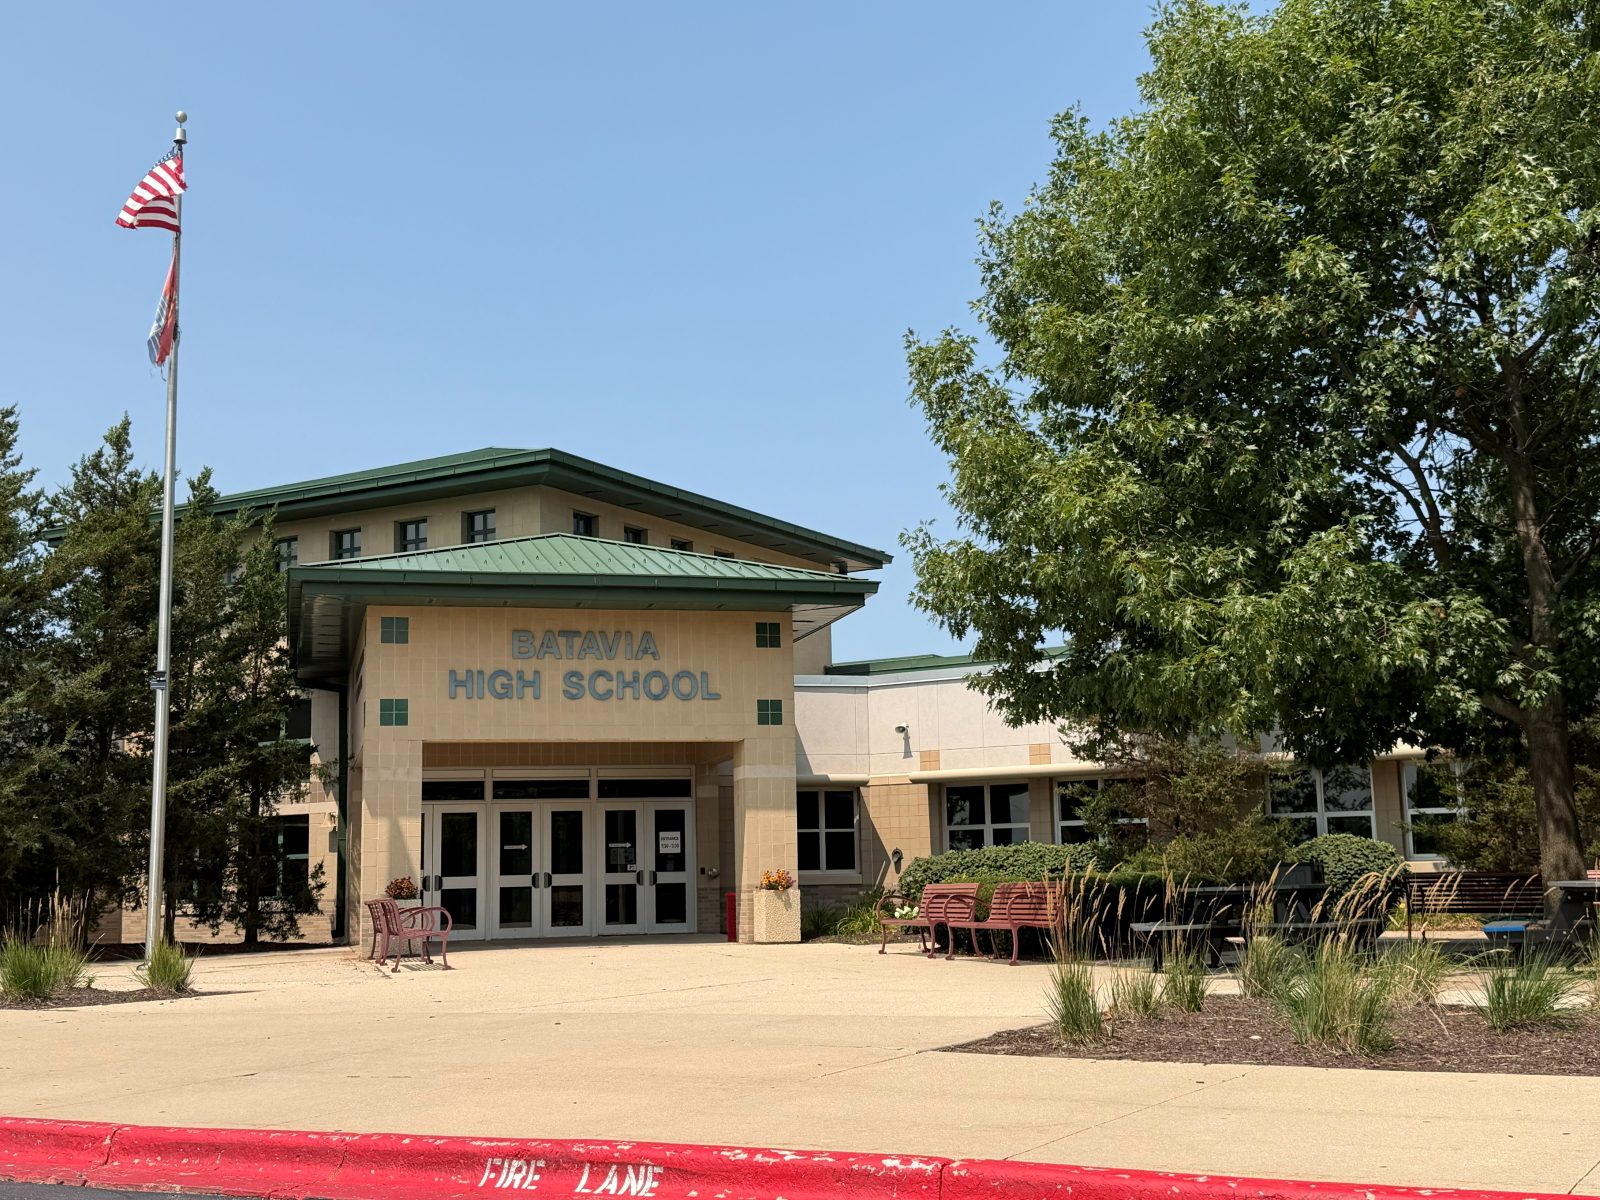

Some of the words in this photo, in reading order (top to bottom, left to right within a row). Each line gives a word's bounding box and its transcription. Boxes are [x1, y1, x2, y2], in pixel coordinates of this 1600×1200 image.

[511, 630, 660, 660] BATAVIA
[449, 669, 541, 700] HIGH
[562, 670, 721, 701] SCHOOL
[478, 1158, 546, 1190] FIRE
[574, 1163, 664, 1197] LANE
